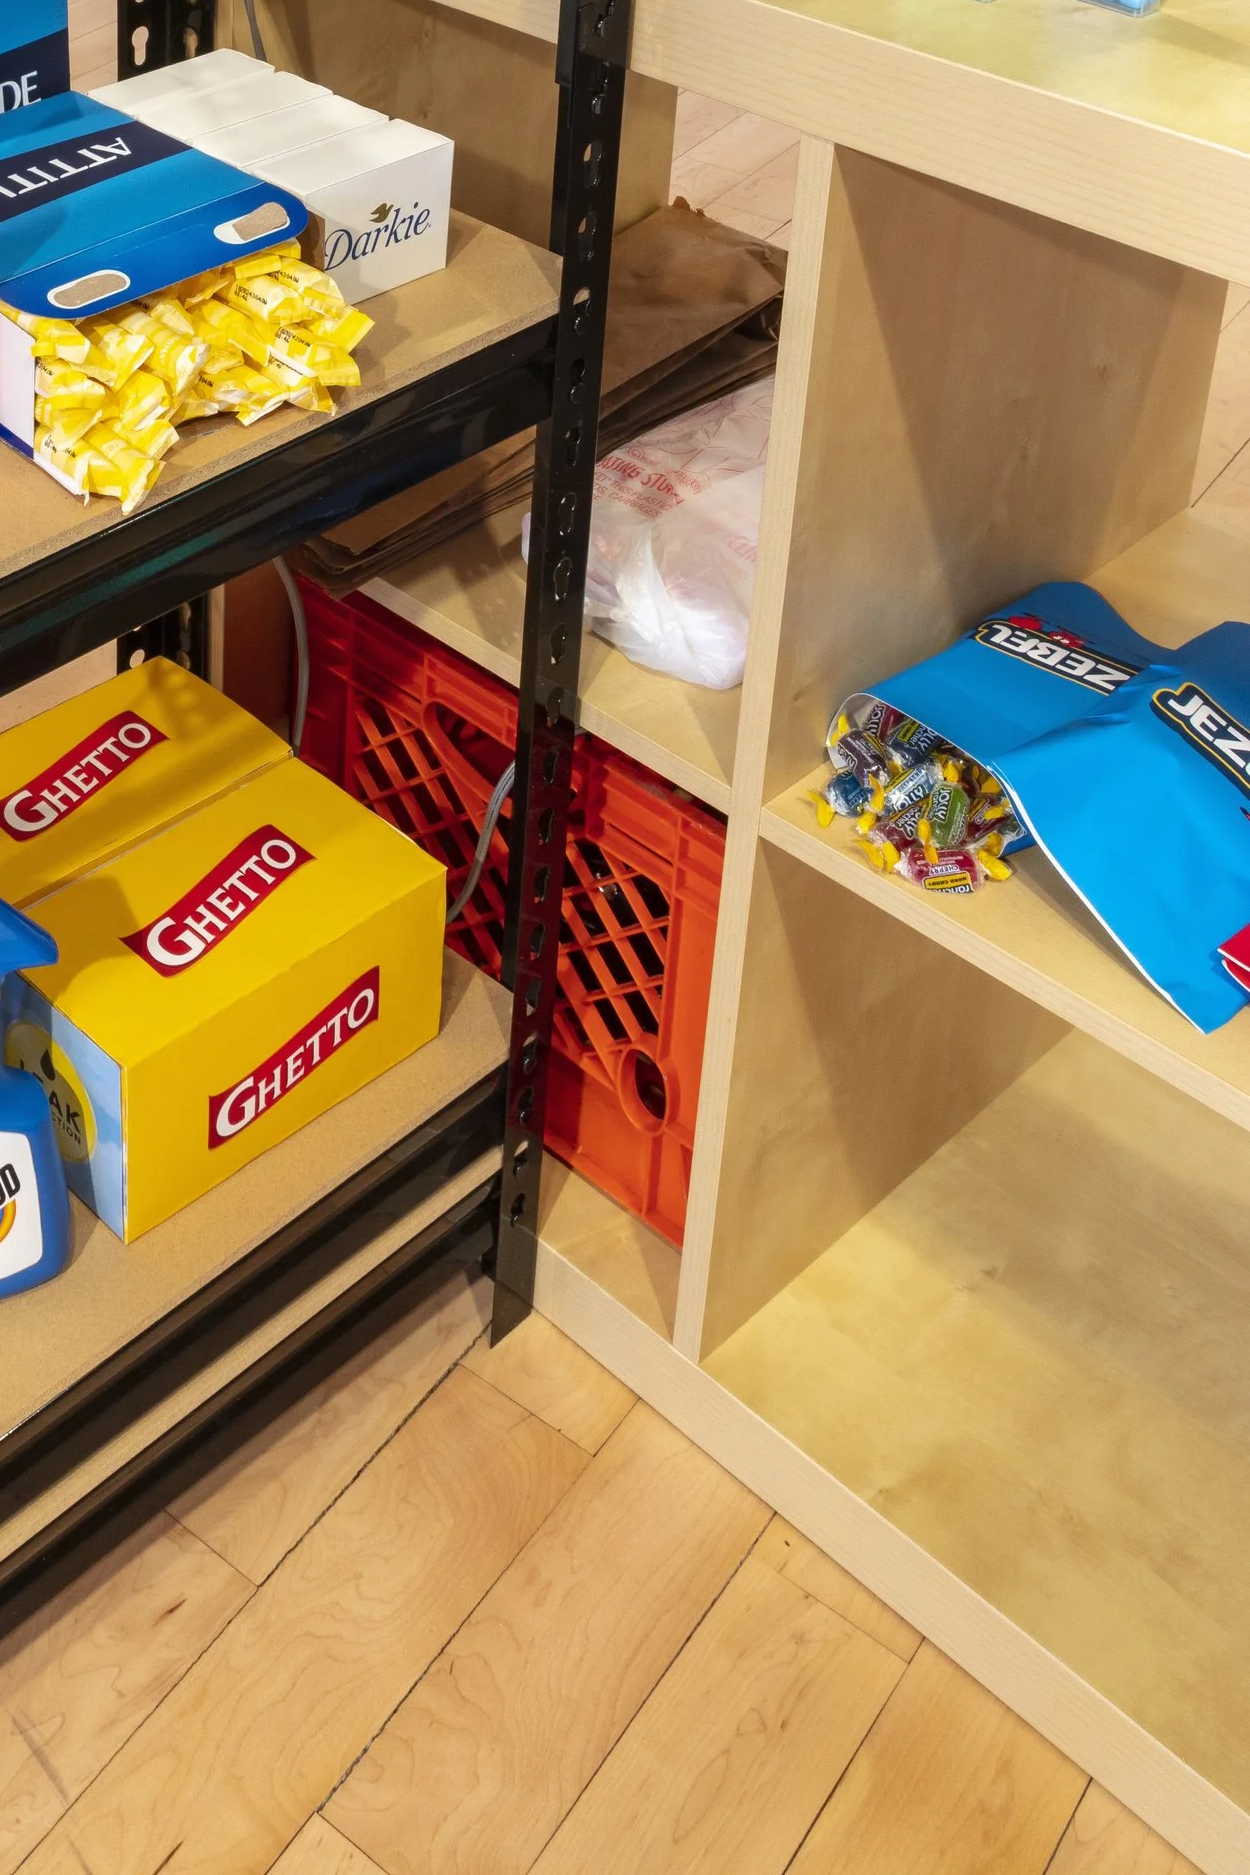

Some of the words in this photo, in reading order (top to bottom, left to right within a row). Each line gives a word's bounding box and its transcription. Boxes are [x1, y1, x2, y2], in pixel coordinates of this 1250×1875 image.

[324, 201, 431, 272] Darkie
[2, 721, 152, 834] GHETTO
[1167, 694, 1250, 776] JEZ
[934, 787, 951, 821] JOLLY
[145, 836, 298, 968] GHETTO
[214, 985, 375, 1138] GHETTO
